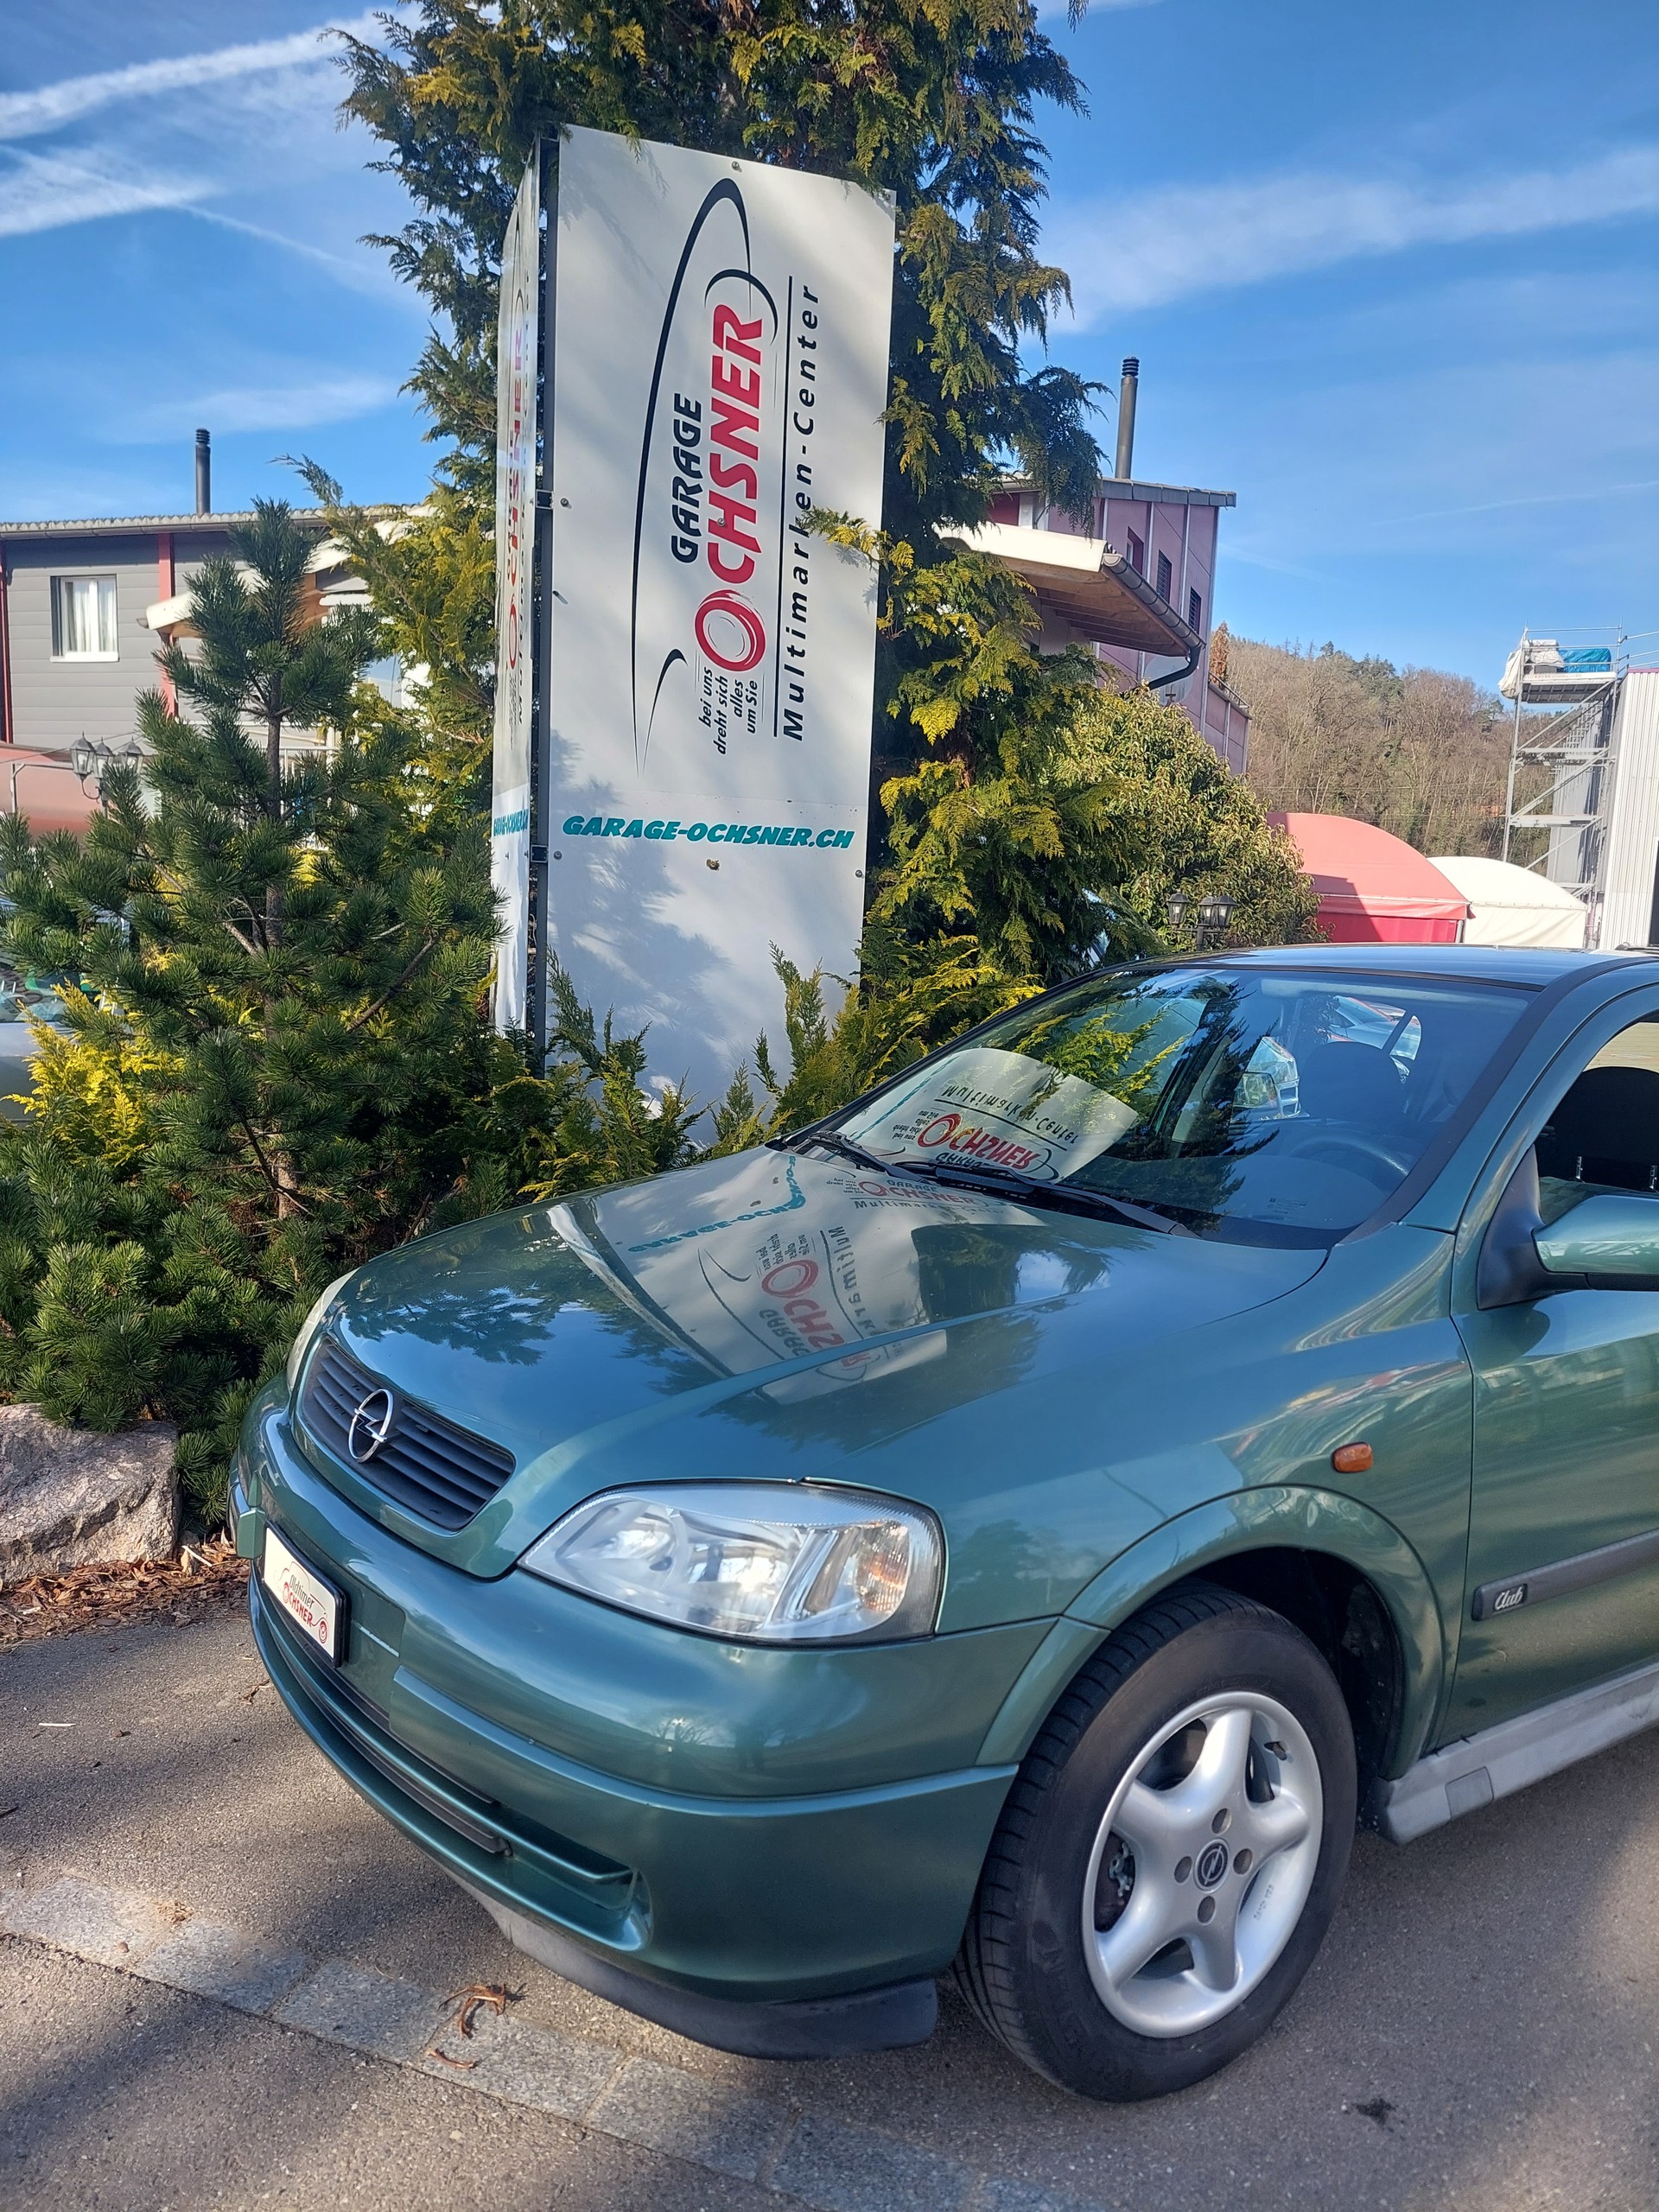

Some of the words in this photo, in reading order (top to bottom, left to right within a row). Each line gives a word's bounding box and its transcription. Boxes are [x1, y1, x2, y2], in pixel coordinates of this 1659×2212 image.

[671, 393, 702, 563] GARAGE
[695, 304, 766, 672] OCHSNER
[783, 286, 820, 741] Multimarken-Center
[704, 667, 713, 696] uns
[715, 676, 728, 708] sich
[729, 679, 744, 718] alles
[746, 680, 758, 707] Sie
[698, 698, 712, 728] bei
[747, 709, 756, 734] um
[713, 709, 728, 755] dreht
[562, 816, 855, 849] GARAGE-OCHSNER.CH
[283, 1581, 314, 1628] OCHSNER
[289, 1574, 315, 1610] Oldtimer
[1494, 1586, 1523, 1611] Club
